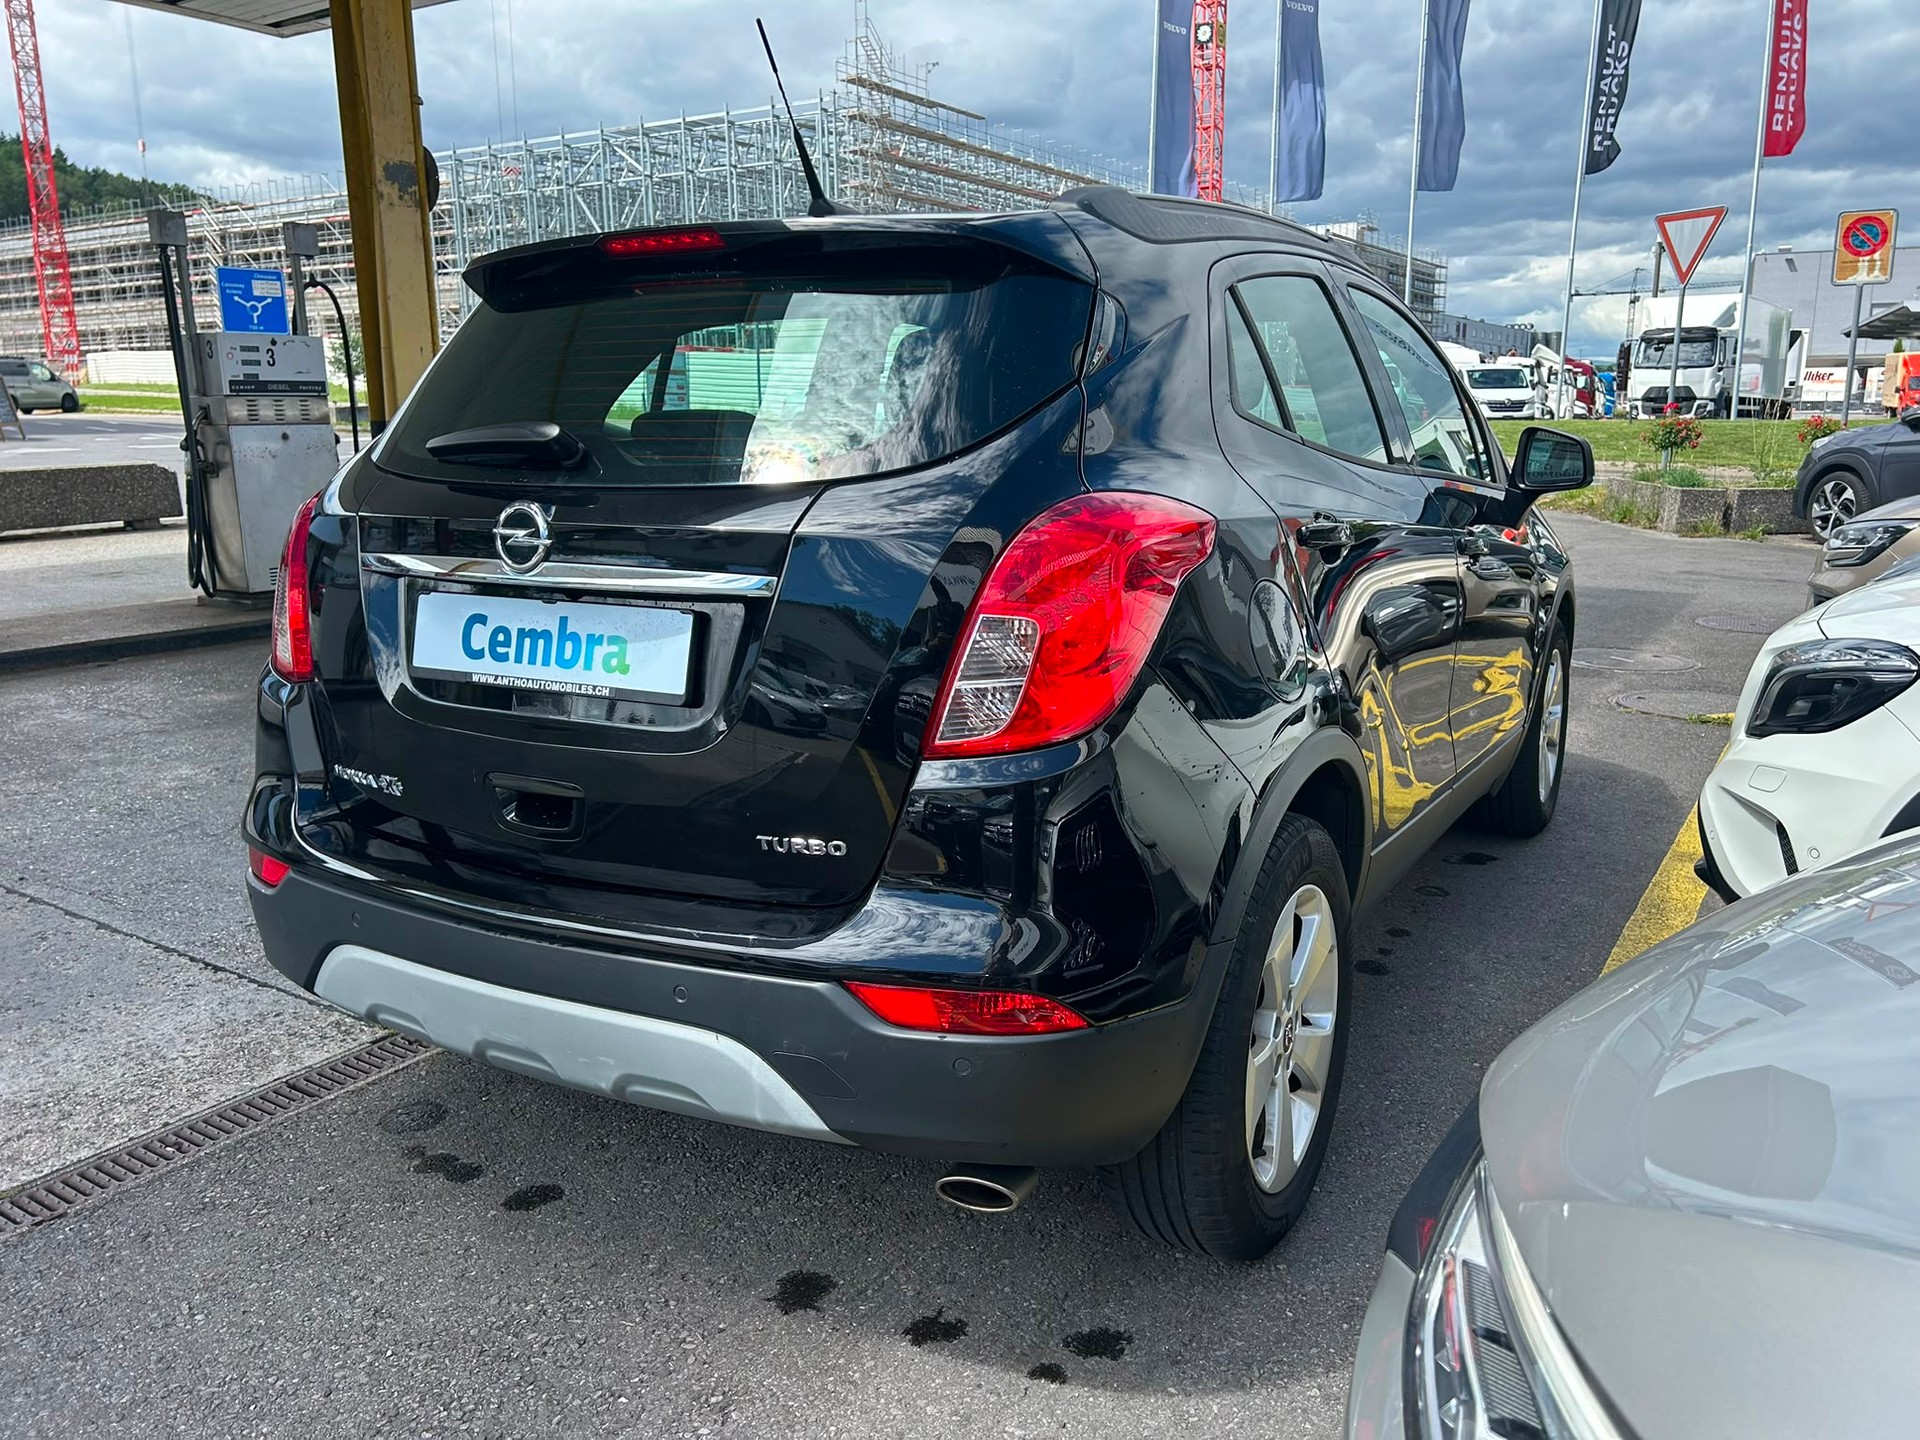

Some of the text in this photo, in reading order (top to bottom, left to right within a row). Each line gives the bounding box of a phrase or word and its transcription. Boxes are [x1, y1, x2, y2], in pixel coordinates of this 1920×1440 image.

[1285, 0, 1314, 13] VOLVO
[1163, 21, 1187, 35] VOLVO
[1772, 0, 1792, 132] RENAULT
[1593, 24, 1616, 152] RENAULT
[206, 340, 214, 359] 3
[266, 348, 276, 367] 3
[1803, 371, 1834, 381] lliker
[267, 383, 291, 391] DIESEL
[461, 612, 631, 676] Cembra
[471, 672, 611, 697] WWW.ANTHOAUTOMOBILES.CH
[755, 835, 847, 856] TURBO
